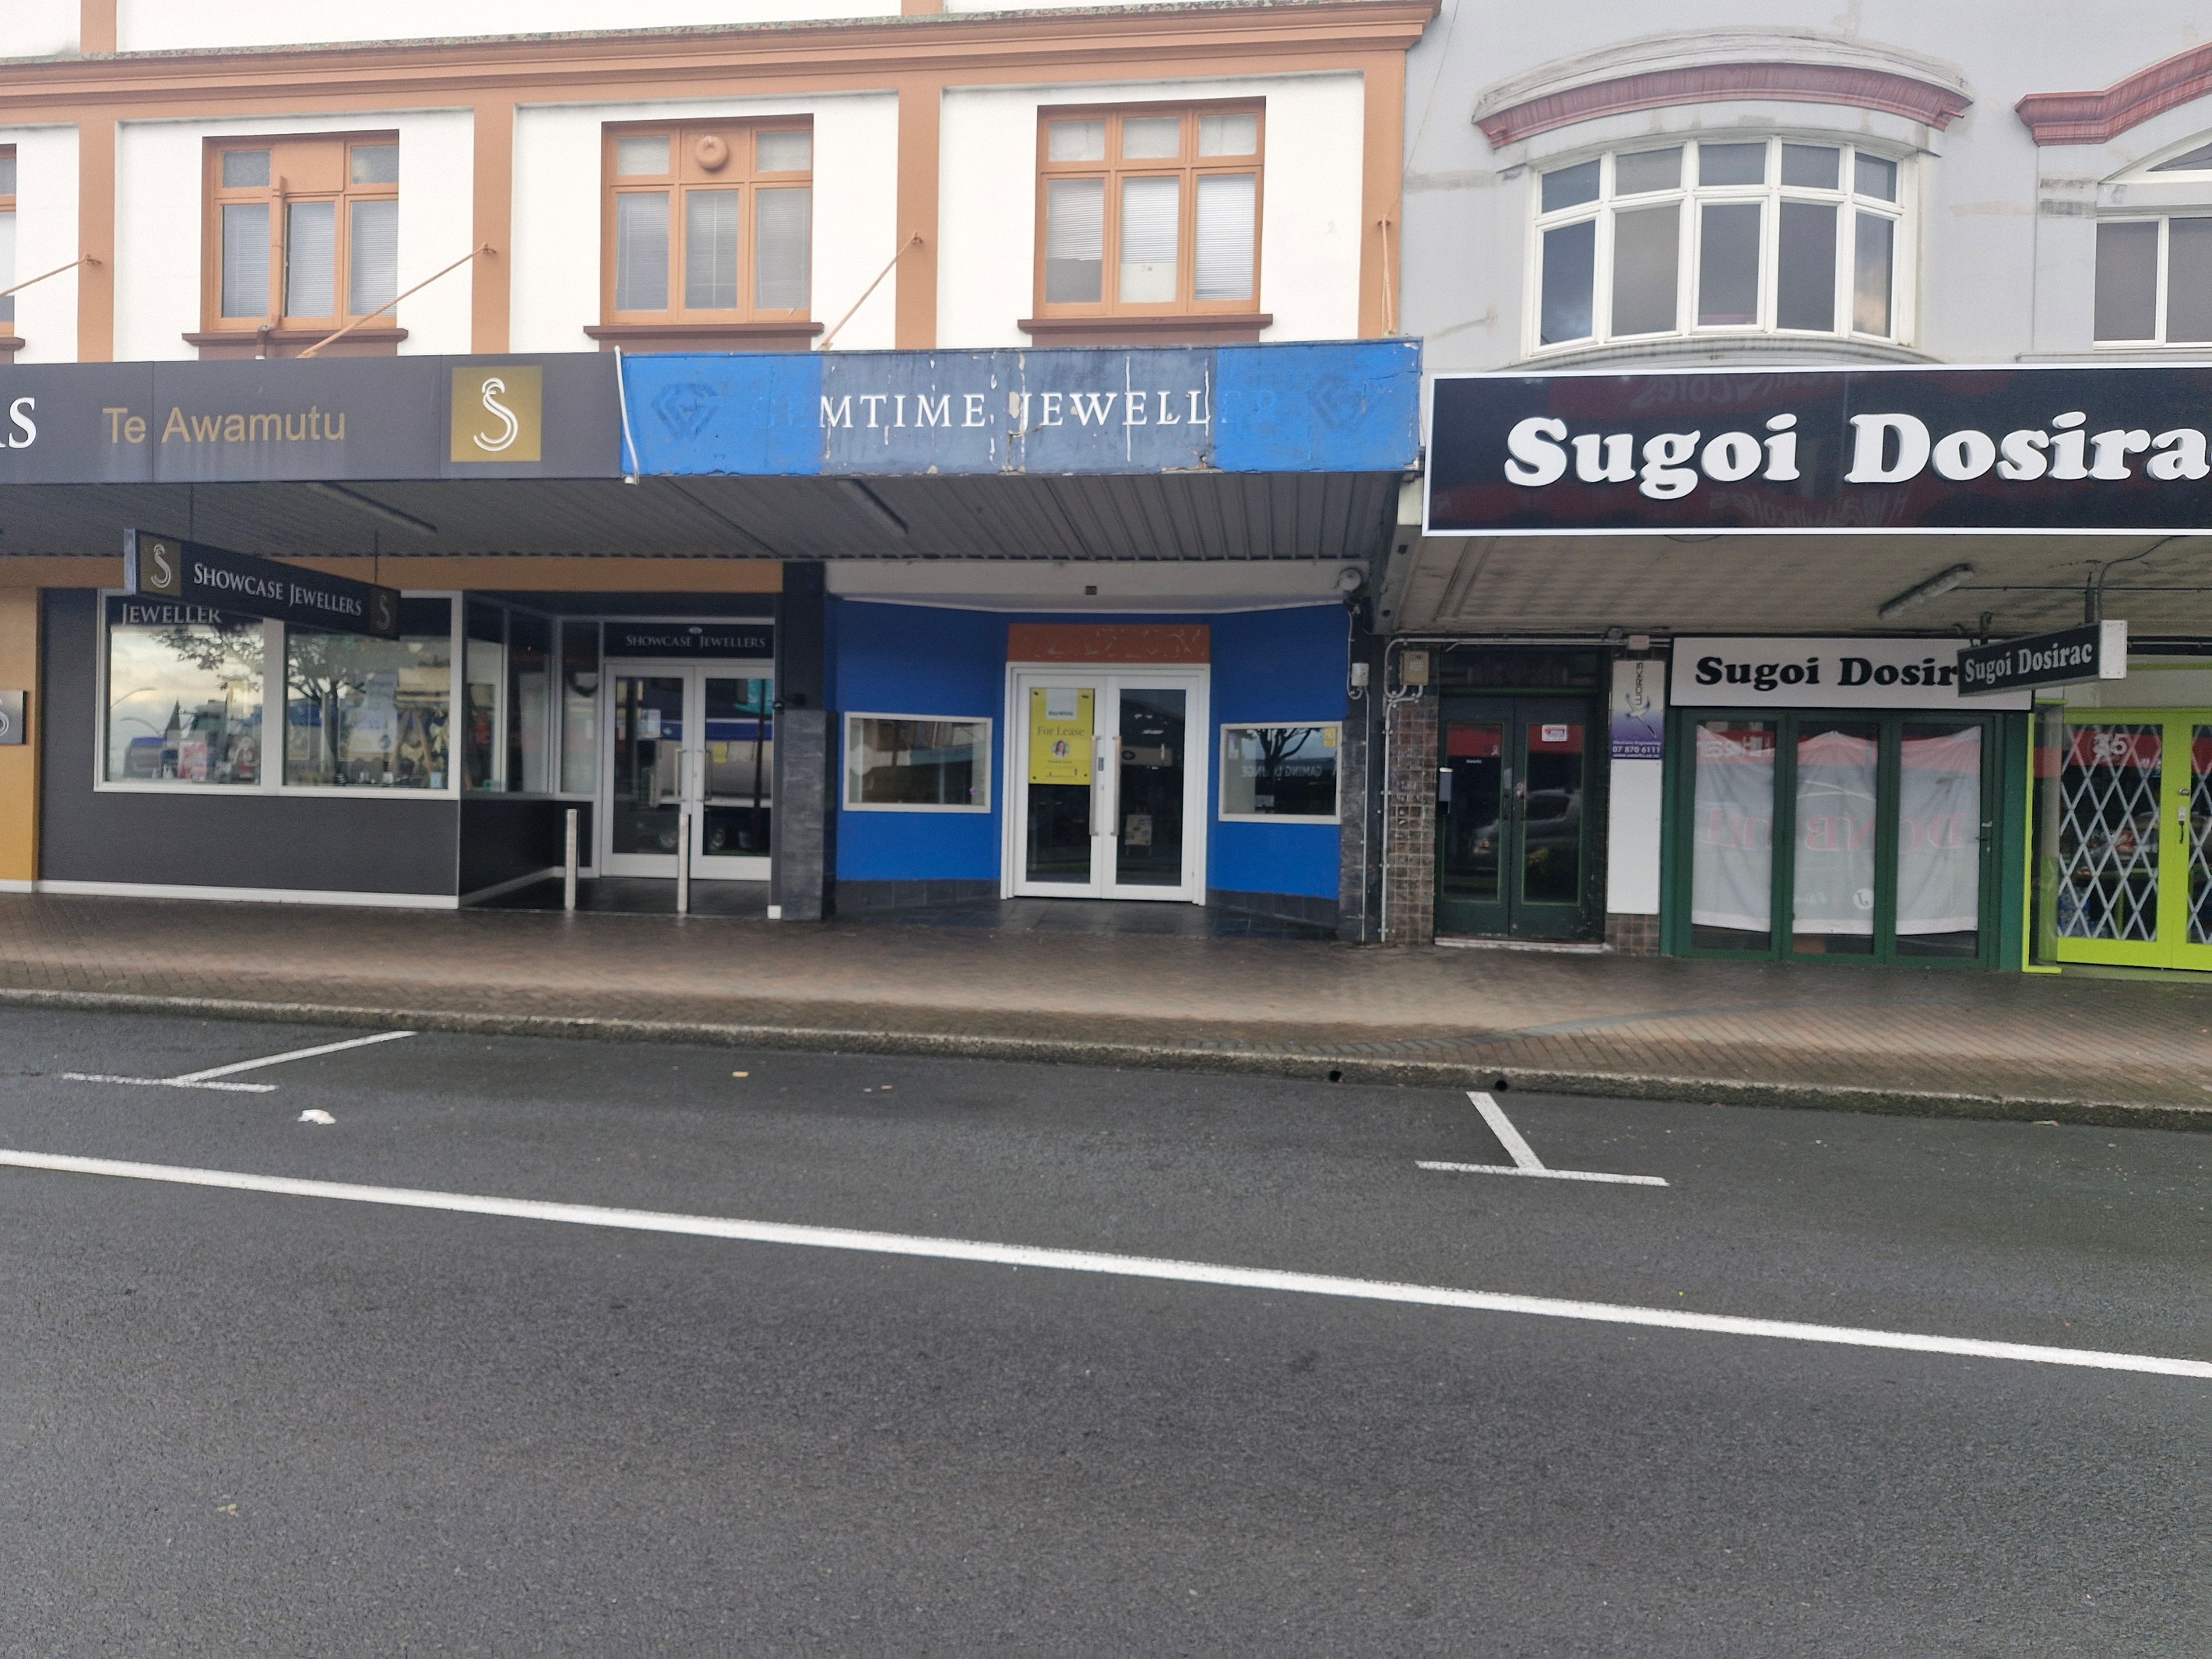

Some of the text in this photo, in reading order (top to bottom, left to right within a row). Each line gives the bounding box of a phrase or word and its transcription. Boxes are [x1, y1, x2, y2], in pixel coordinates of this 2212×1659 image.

[0, 396, 37, 449] S
[102, 405, 346, 444] Te Awamutu
[1504, 411, 2212, 500] Sugoi Dosira
[194, 561, 362, 617] SHOWCASE JEWELLERS
[625, 634, 766, 649] SHOWCASE JEWELLERS
[1695, 656, 1959, 692] Sugoi Dosir
[1964, 642, 2094, 685] Sugoi Dosirac
[1037, 726, 1085, 736] For Lease
